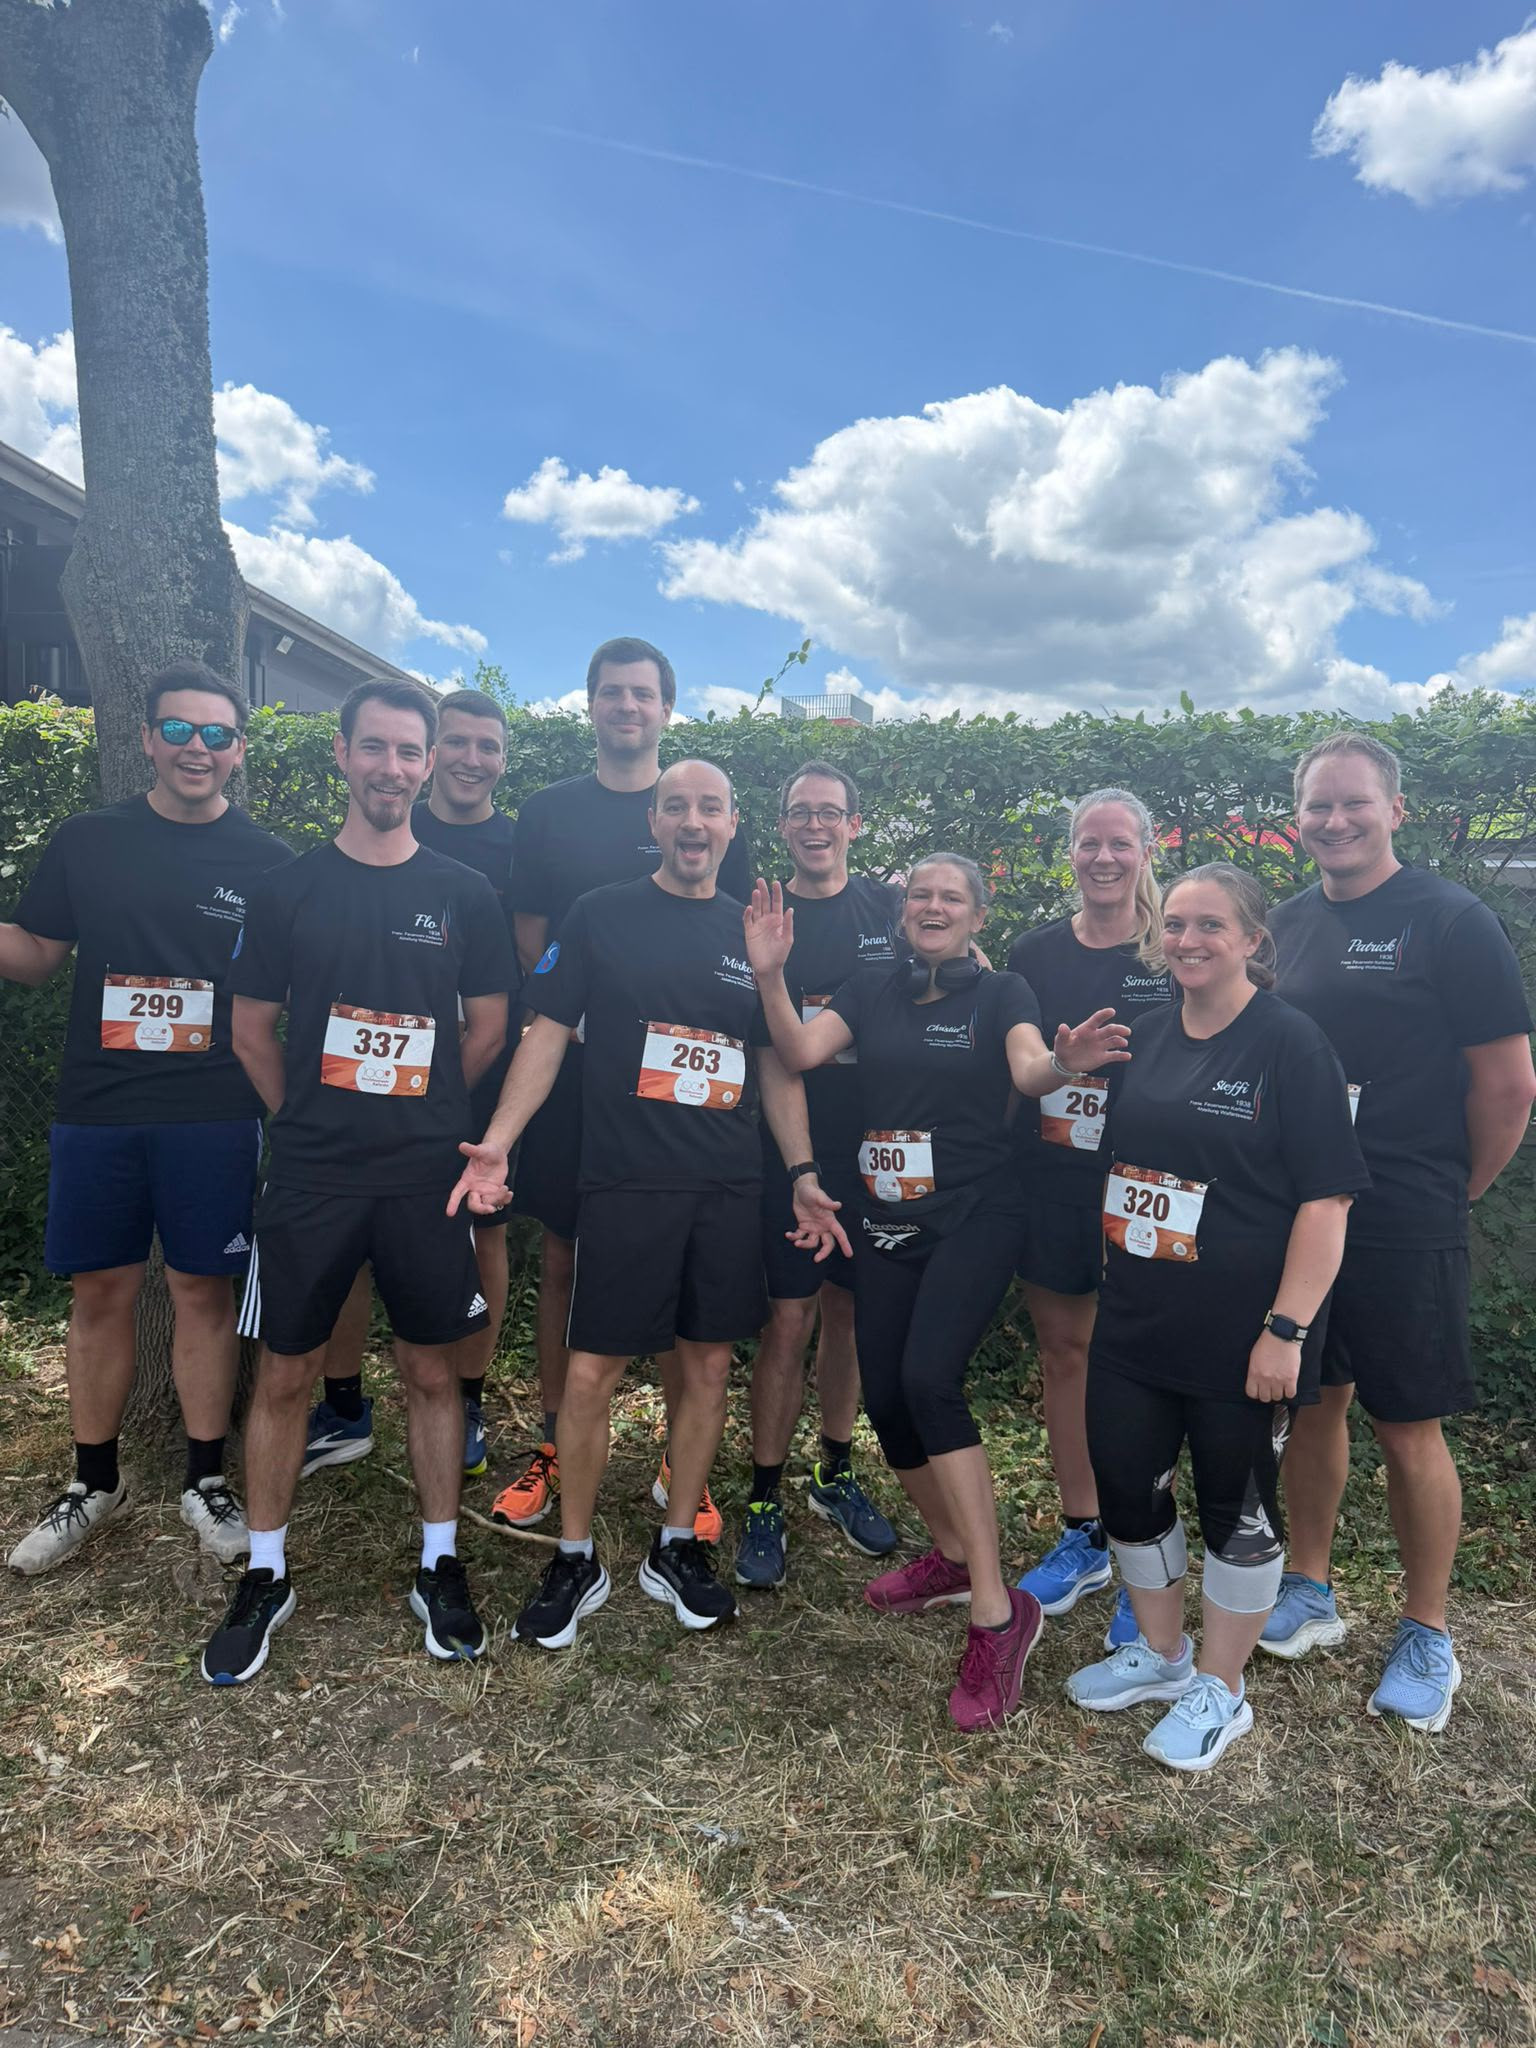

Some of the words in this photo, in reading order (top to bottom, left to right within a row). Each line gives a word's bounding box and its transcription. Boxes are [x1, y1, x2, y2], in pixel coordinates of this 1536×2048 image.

[213, 886, 247, 906] Max
[414, 913, 438, 929] Flo
[858, 933, 888, 949] Jonas
[1347, 938, 1397, 953] Patrick
[721, 955, 753, 974] Mirko
[1122, 975, 1168, 988] Simone
[129, 992, 184, 1019] 299
[353, 1028, 411, 1060] 337
[671, 1043, 721, 1075] 263
[1212, 1080, 1250, 1097] Steffi
[869, 1147, 906, 1172] 360
[1123, 1186, 1170, 1221] 320
[863, 1217, 920, 1232] Reebok
[223, 1244, 250, 1254] adidas
[467, 1302, 488, 1318] adidas
